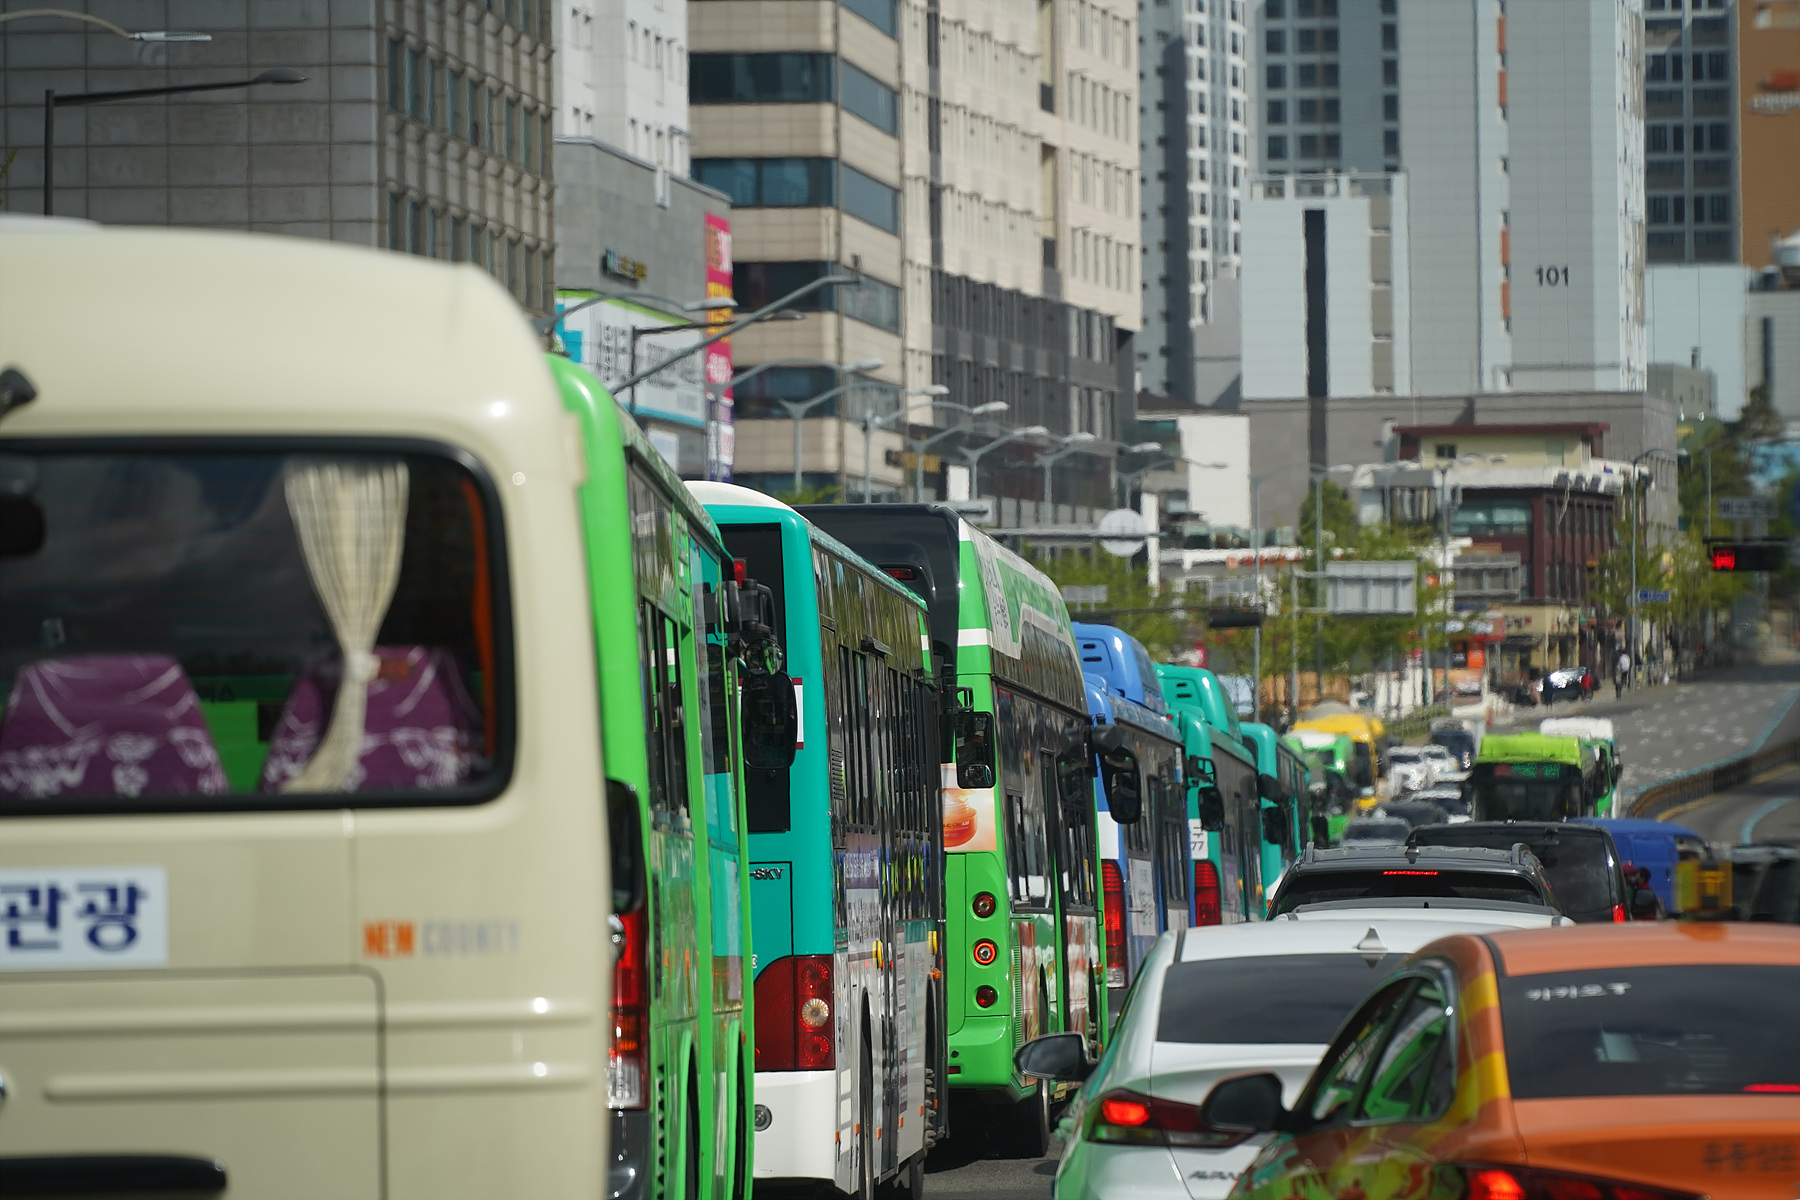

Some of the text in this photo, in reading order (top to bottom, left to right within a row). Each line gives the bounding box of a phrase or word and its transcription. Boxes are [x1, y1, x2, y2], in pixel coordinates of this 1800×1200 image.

[1534, 265, 1569, 287] 101
[0, 883, 148, 953] 관광
[363, 919, 522, 958] NEW COUNTY
